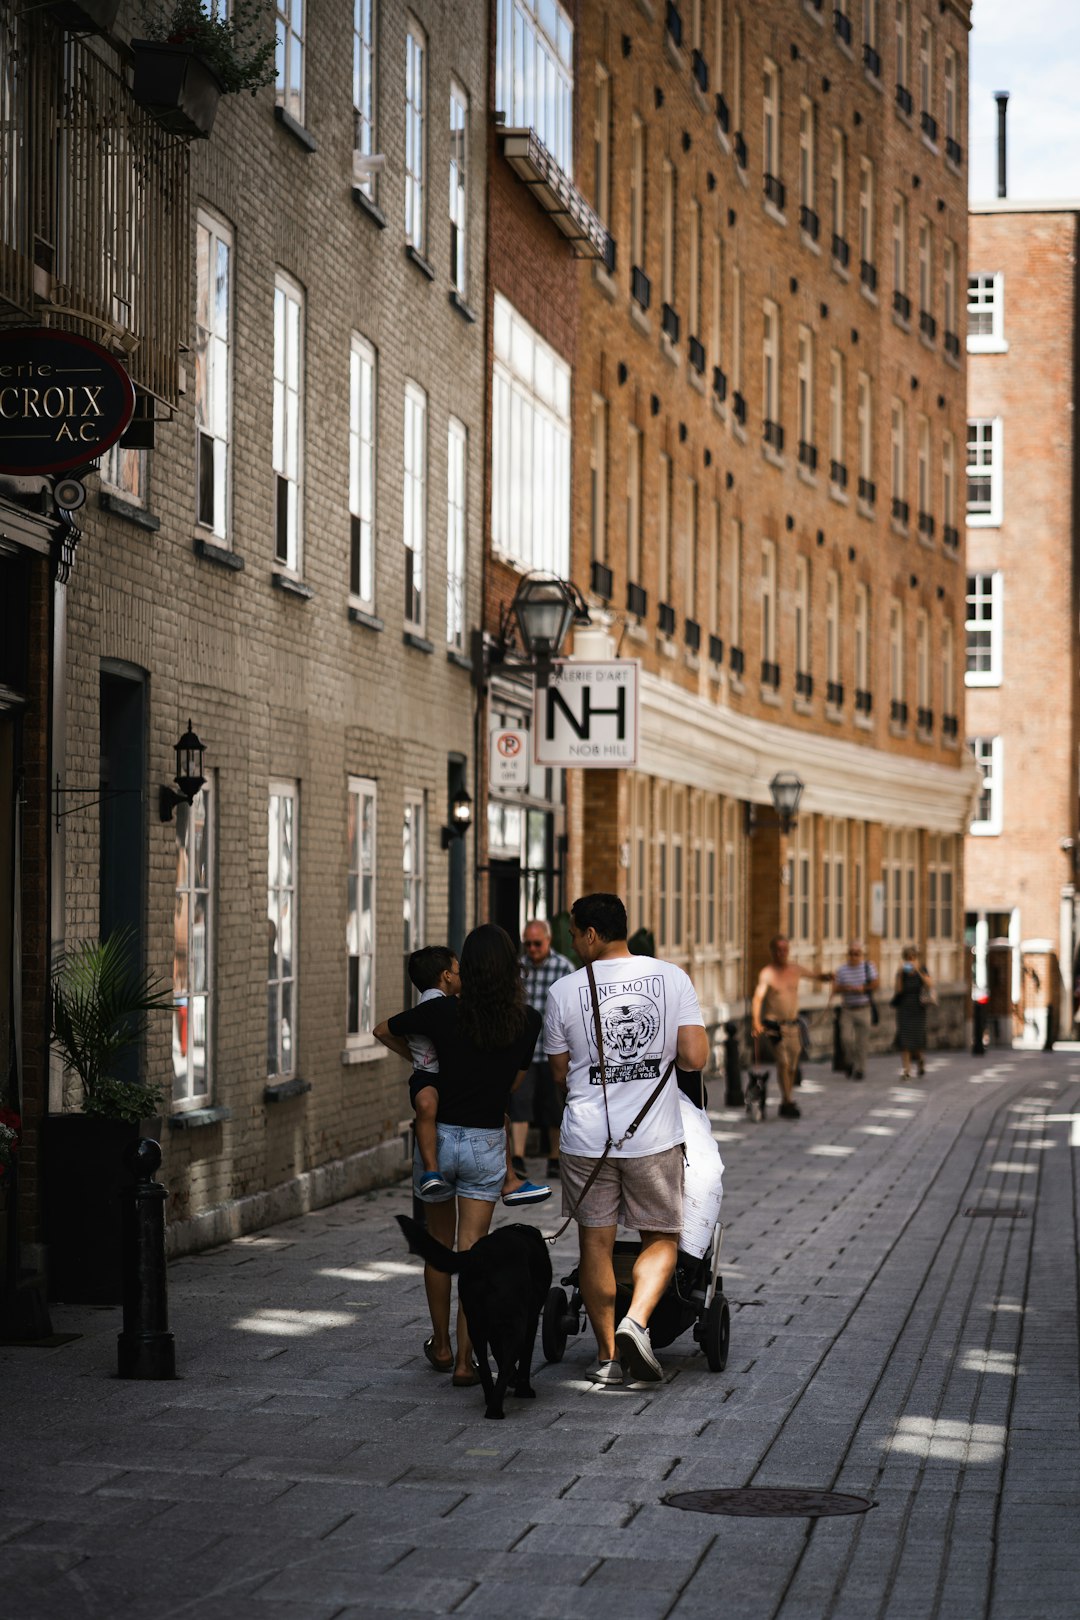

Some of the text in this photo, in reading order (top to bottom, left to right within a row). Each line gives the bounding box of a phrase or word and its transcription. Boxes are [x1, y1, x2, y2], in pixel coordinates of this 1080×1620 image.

[0, 361, 52, 377] erie
[0, 386, 104, 418] CROIX
[56, 422, 100, 442] A.C.
[554, 671, 628, 682] ALERIE D'ART
[546, 686, 626, 741] NH
[569, 744, 628, 757] NOB HILL
[584, 977, 661, 1012] JNE MOTO
[640, 1071, 657, 1079] YORK
